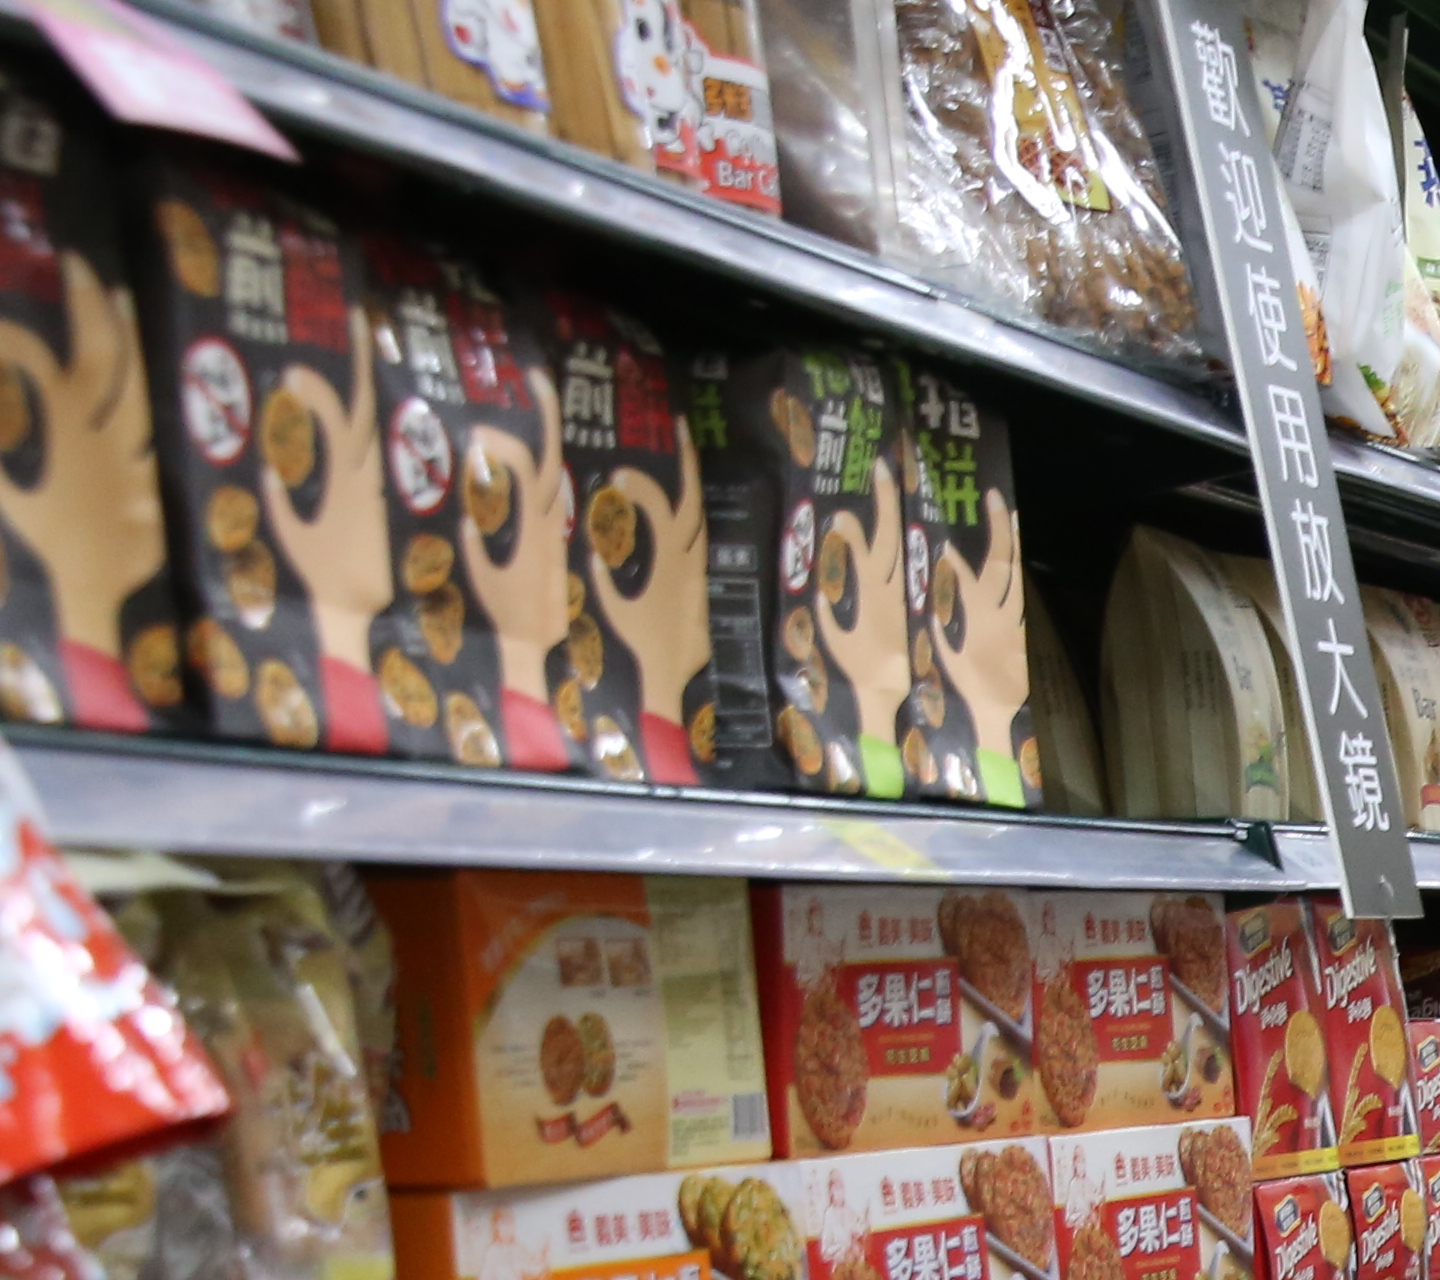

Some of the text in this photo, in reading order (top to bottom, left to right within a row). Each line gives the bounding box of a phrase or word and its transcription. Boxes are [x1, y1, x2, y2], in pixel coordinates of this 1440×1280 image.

[1190, 20, 1392, 834] 歡迎使用放大鏡
[1235, 936, 1294, 1015] Digestive
[1325, 935, 1377, 1009] Digestive
[1117, 1206, 1181, 1259] 多果仁
